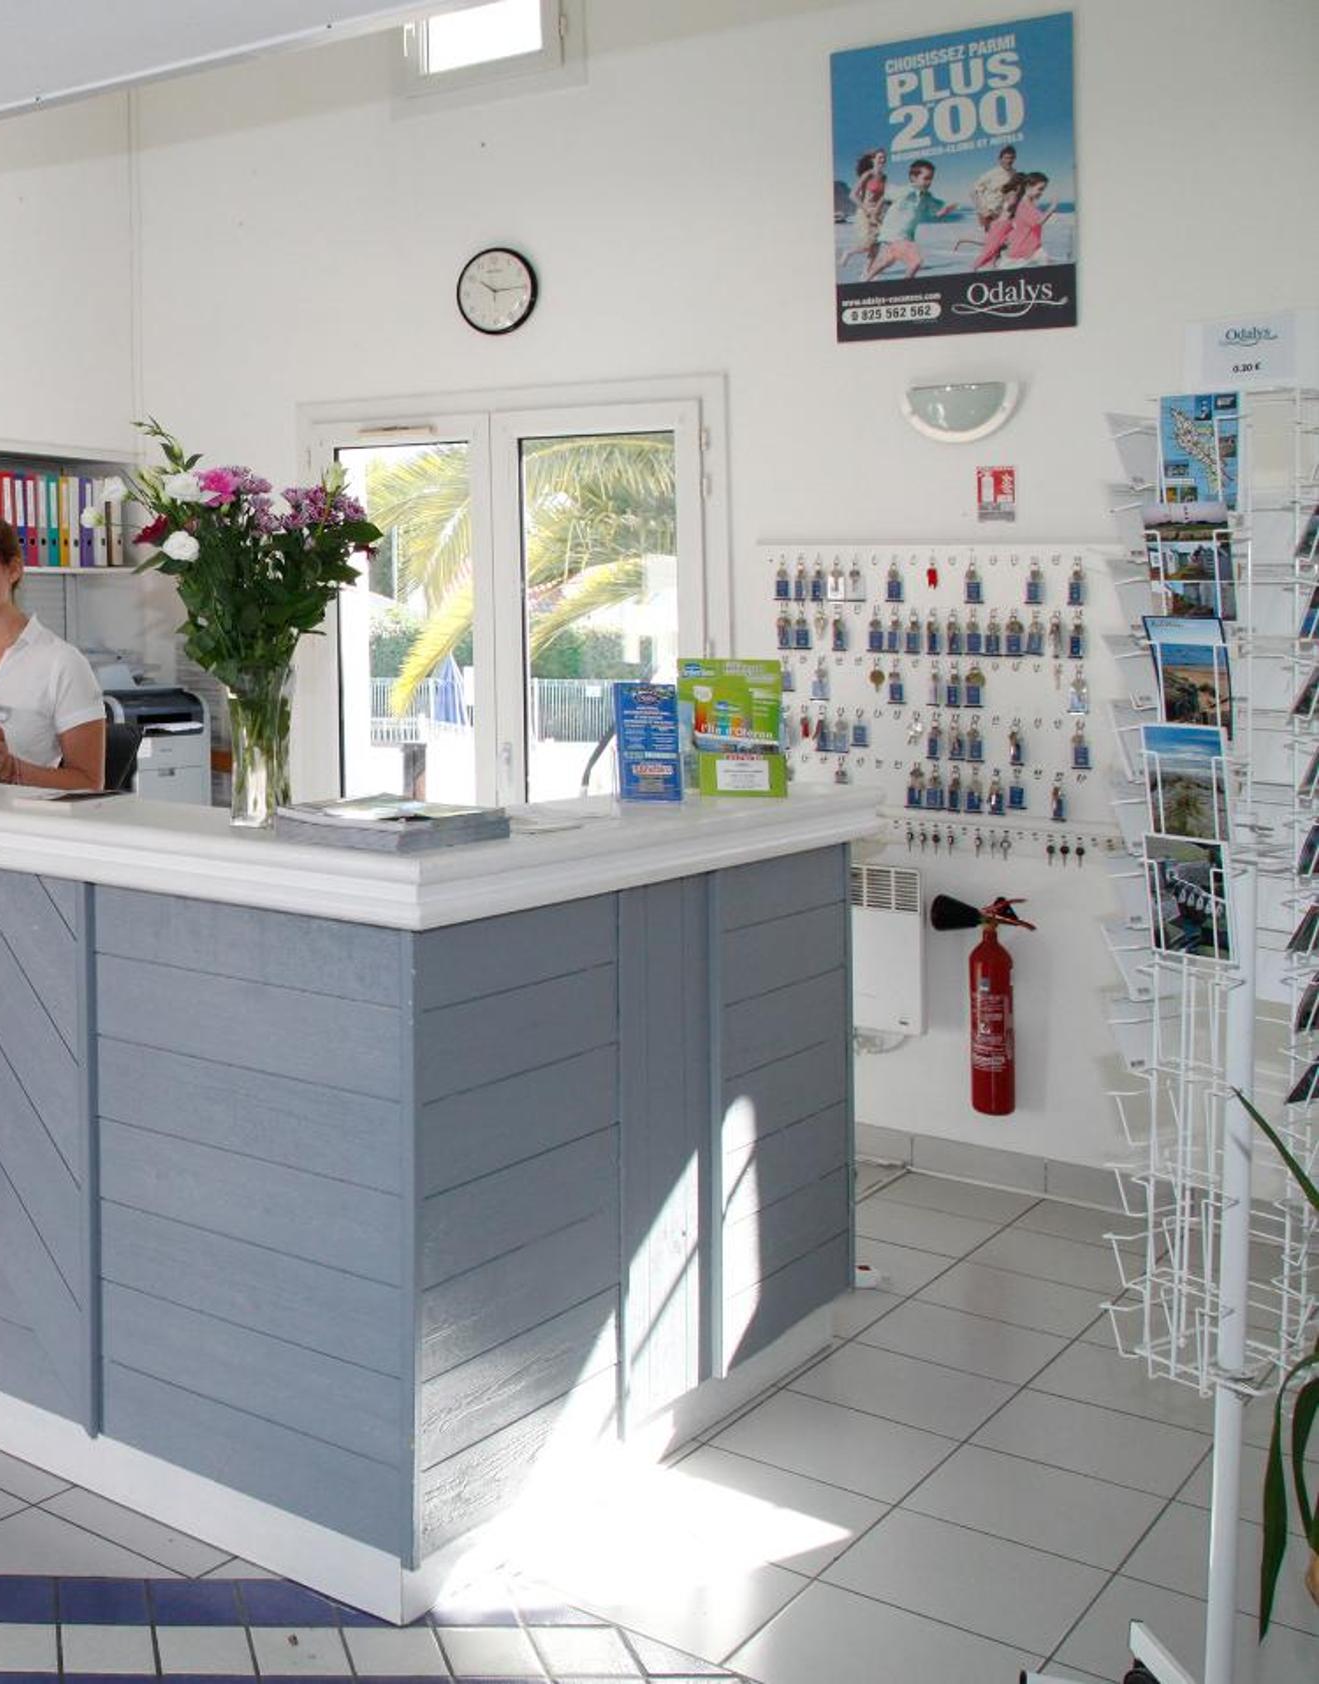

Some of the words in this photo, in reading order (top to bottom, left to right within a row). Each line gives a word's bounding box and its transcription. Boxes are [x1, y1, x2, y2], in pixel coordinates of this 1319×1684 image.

[885, 44, 966, 73] CHOISISSEZ
[968, 33, 1017, 57] PARMI
[886, 51, 1022, 109] PLUS
[889, 88, 1025, 154] 200
[966, 279, 1054, 310] Odalys
[861, 309, 882, 321] 825
[885, 307, 906, 319] 562
[910, 304, 931, 317] 562
[1225, 326, 1273, 342] Odalys
